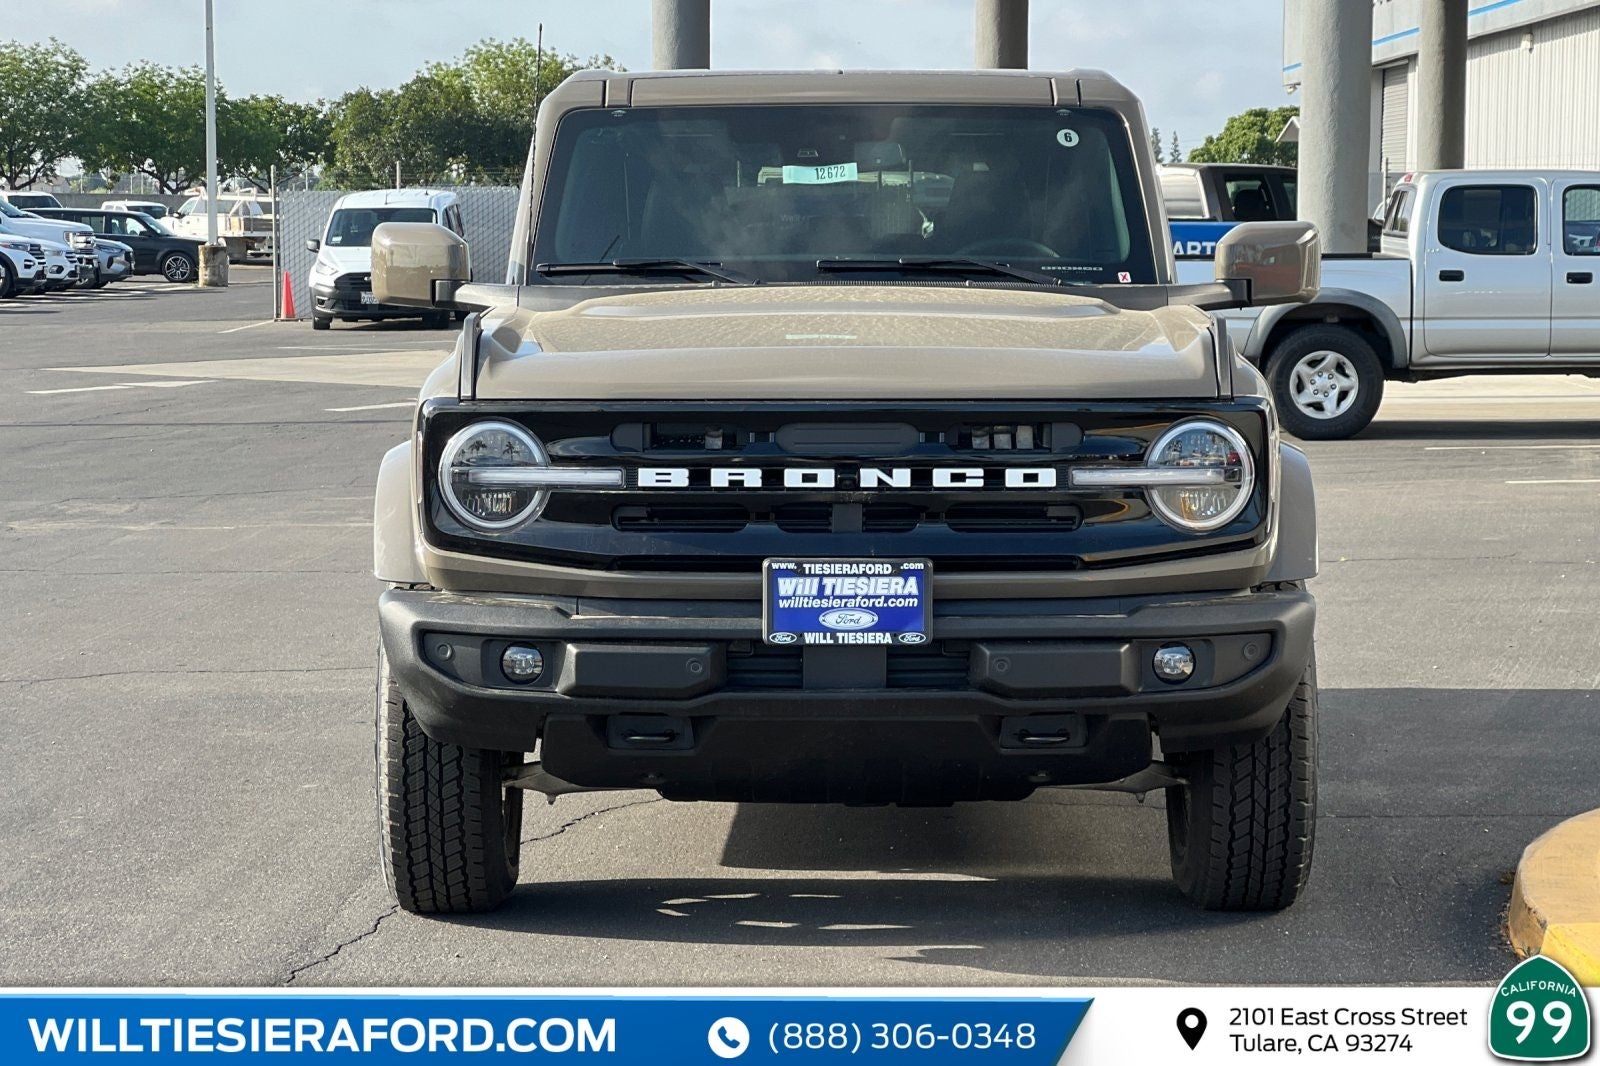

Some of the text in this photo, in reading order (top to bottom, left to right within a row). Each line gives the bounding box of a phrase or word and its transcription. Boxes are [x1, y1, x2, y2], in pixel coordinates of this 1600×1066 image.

[1063, 131, 1073, 143] 6
[814, 165, 846, 181] 12672
[637, 467, 1057, 488] BRONCO
[771, 562, 925, 575] www. TIESIERAFORD .com
[822, 576, 919, 596] TIESIERA
[778, 597, 918, 608] willtiesieraford.com
[835, 613, 862, 625] Ford
[803, 633, 893, 644] WILL TIESIERA
